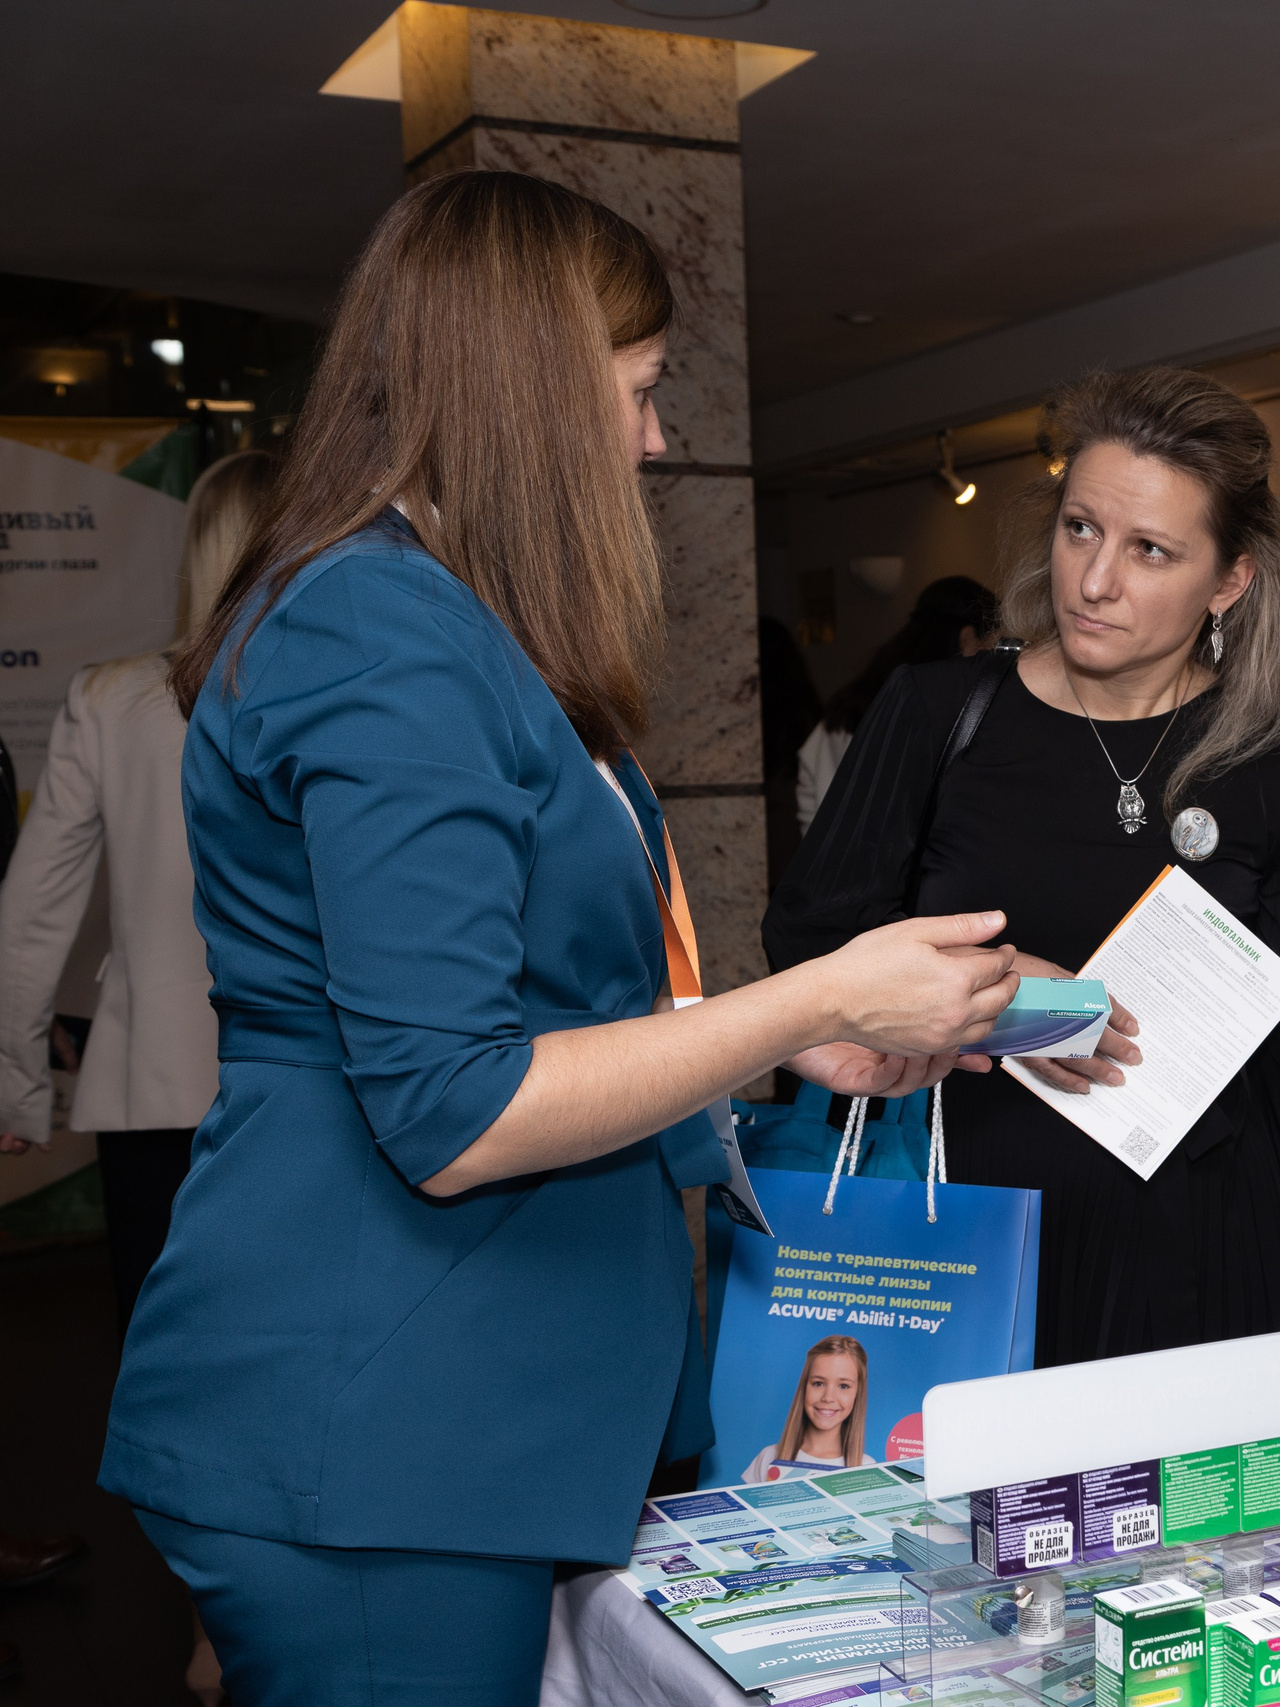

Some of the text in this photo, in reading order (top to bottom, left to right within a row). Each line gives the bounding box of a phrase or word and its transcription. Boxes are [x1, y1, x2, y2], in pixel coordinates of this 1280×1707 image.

[0, 504, 95, 530] ивый
[0, 649, 39, 668] on
[1202, 908, 1262, 962] ИНДОФТАЛЬМИК
[777, 1245, 977, 1275] Новые терапевтические
[774, 1267, 931, 1291] контактные линзы
[771, 1285, 952, 1312] для контроля миопии
[846, 1310, 895, 1327] Abiliti
[1116, 1509, 1155, 1523] ОБРАЗЕЦ
[1029, 1525, 1069, 1538] ОБРАЗЕЦ
[1121, 1519, 1150, 1534] НЕ ДЛЯ
[1034, 1535, 1063, 1549] НЕ ДЛЯ
[1116, 1529, 1156, 1547] ПРОДАЖИ
[1028, 1547, 1069, 1563] ПРОДАЖИ
[786, 1633, 875, 1649] ОНЛАЙН-ФОРМАТЕ
[792, 1637, 927, 1660] ДИАГНОСТИКИ
[815, 1643, 930, 1663] ИНСТРУМЕНТ
[1129, 1640, 1204, 1670] Систейн
[757, 1657, 788, 1669] ССГ
[1155, 1666, 1179, 1679] УЛЬТРА
